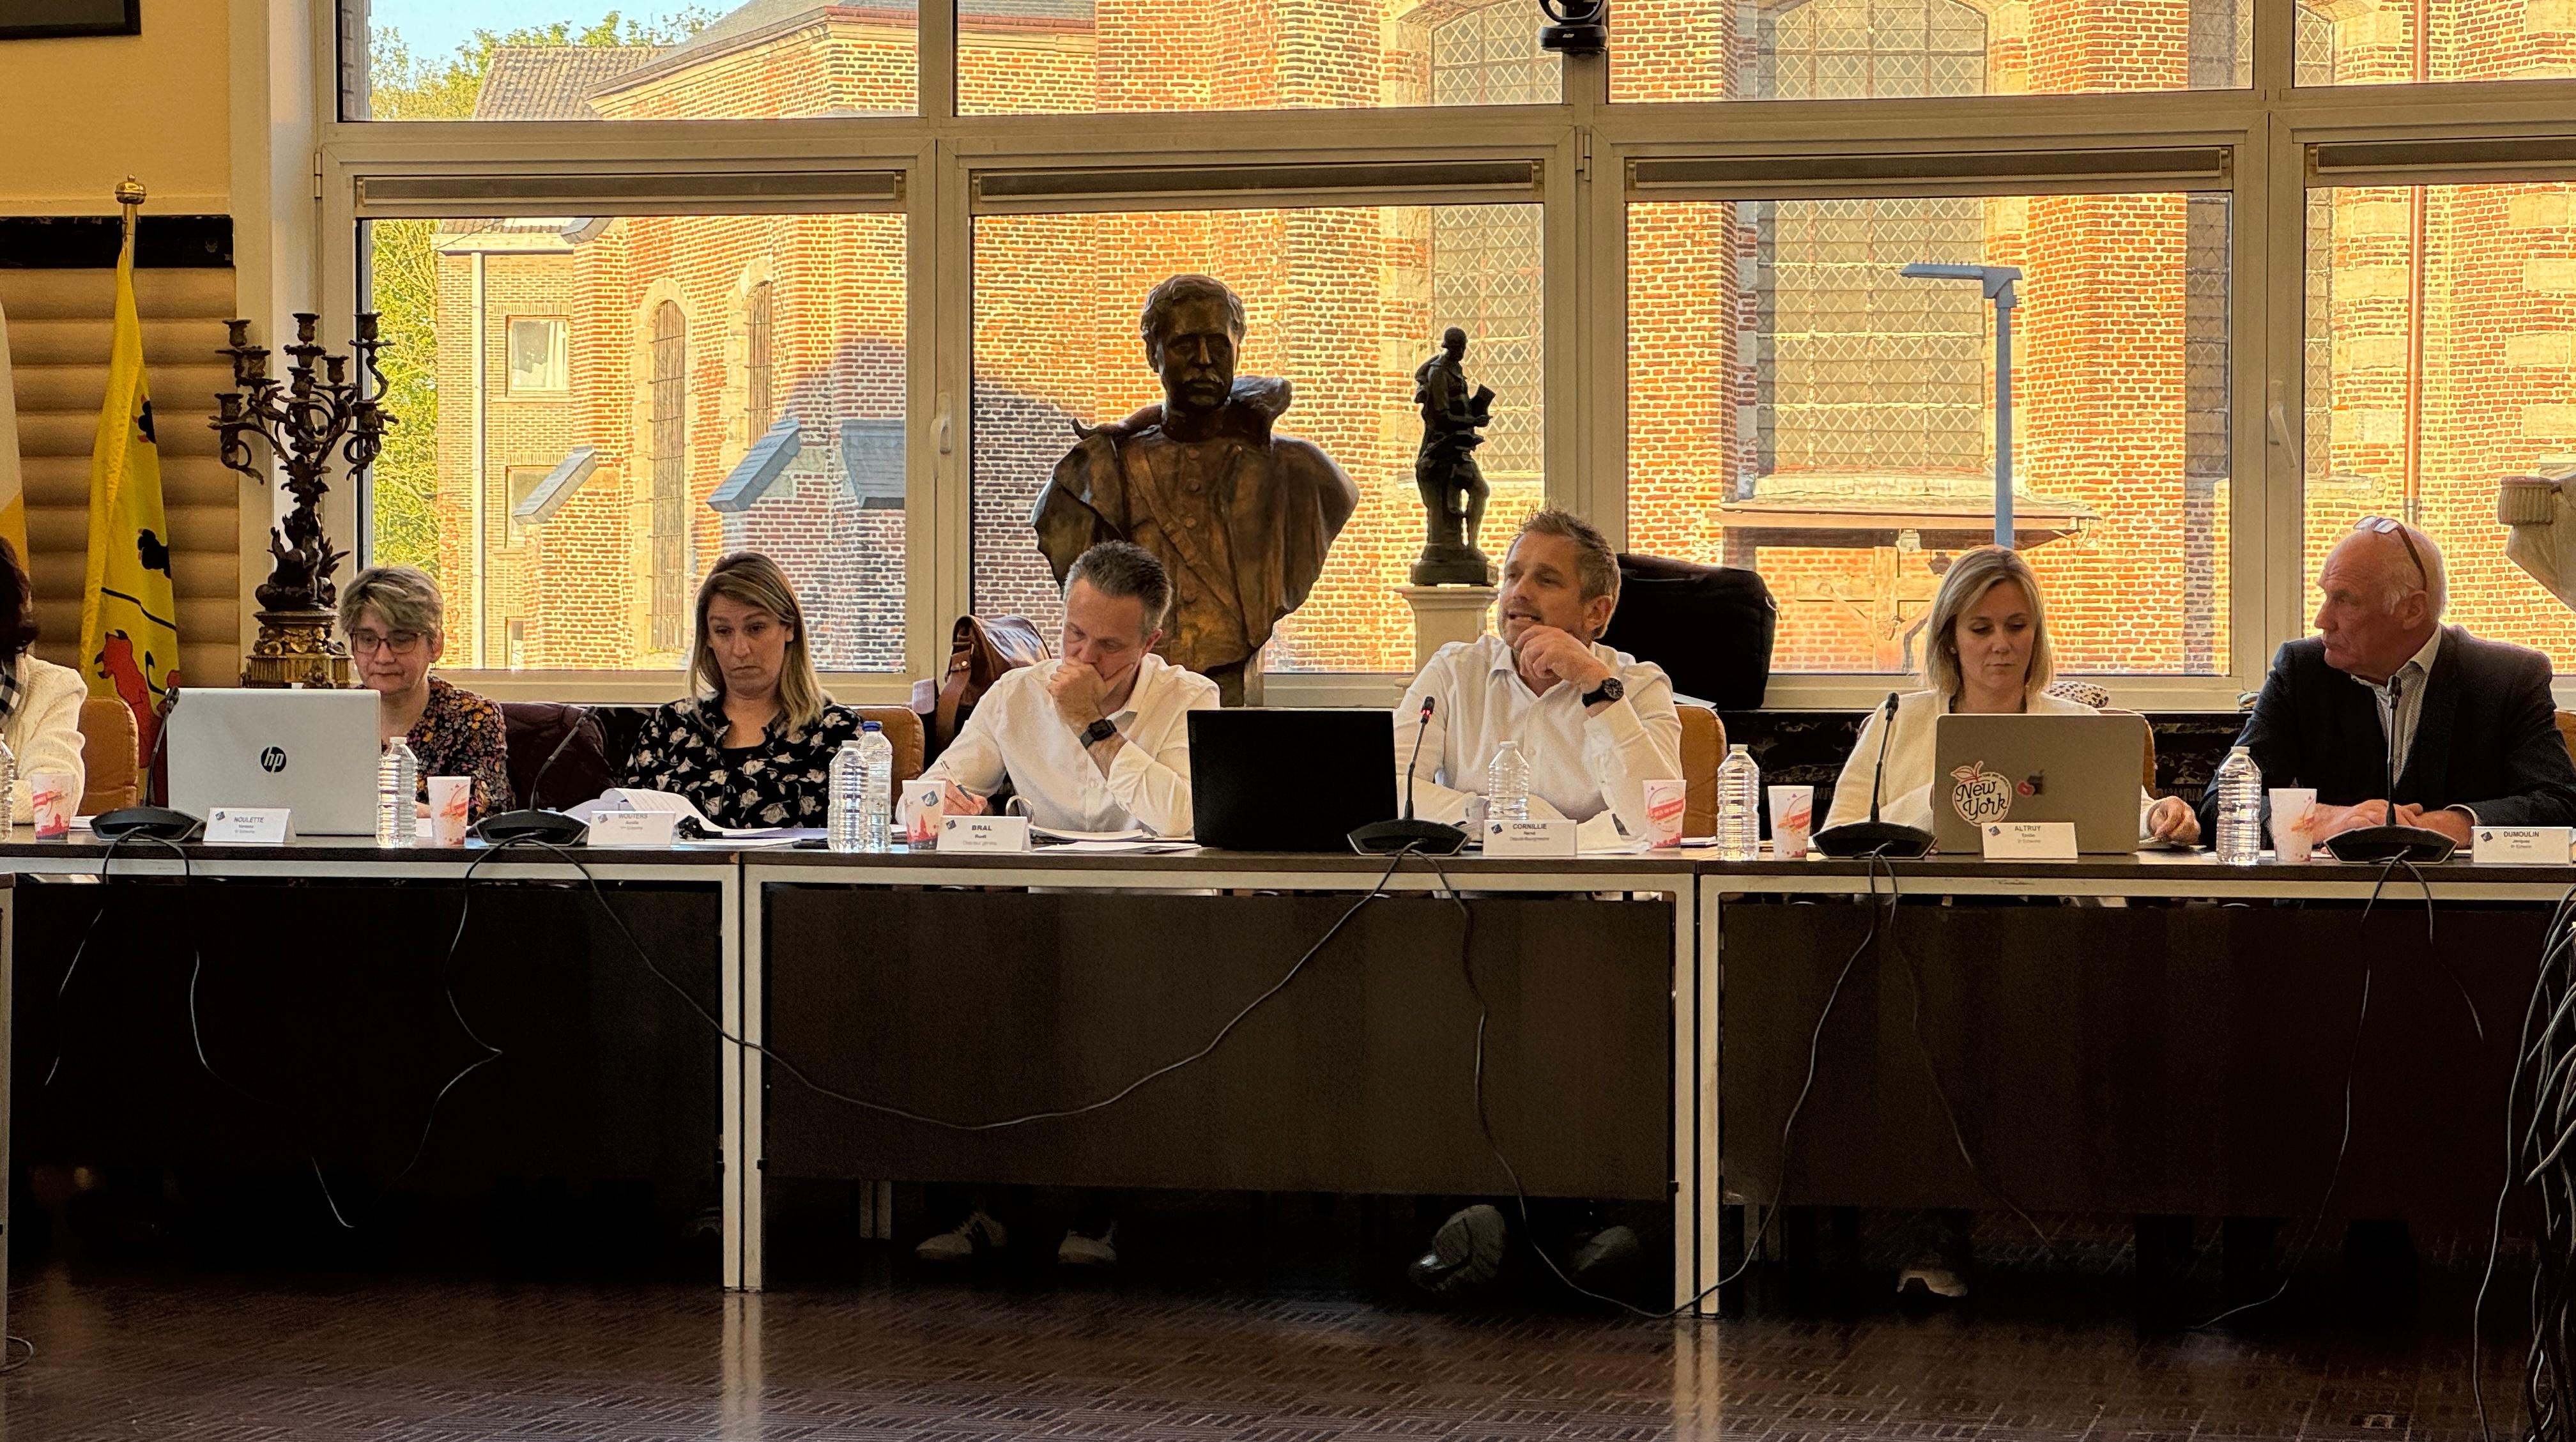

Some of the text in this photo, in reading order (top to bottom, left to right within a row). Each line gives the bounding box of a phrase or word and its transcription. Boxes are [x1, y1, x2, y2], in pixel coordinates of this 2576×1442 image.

[263, 746, 284, 773] hp
[1956, 781, 1997, 802] New
[1963, 793, 2007, 821] York
